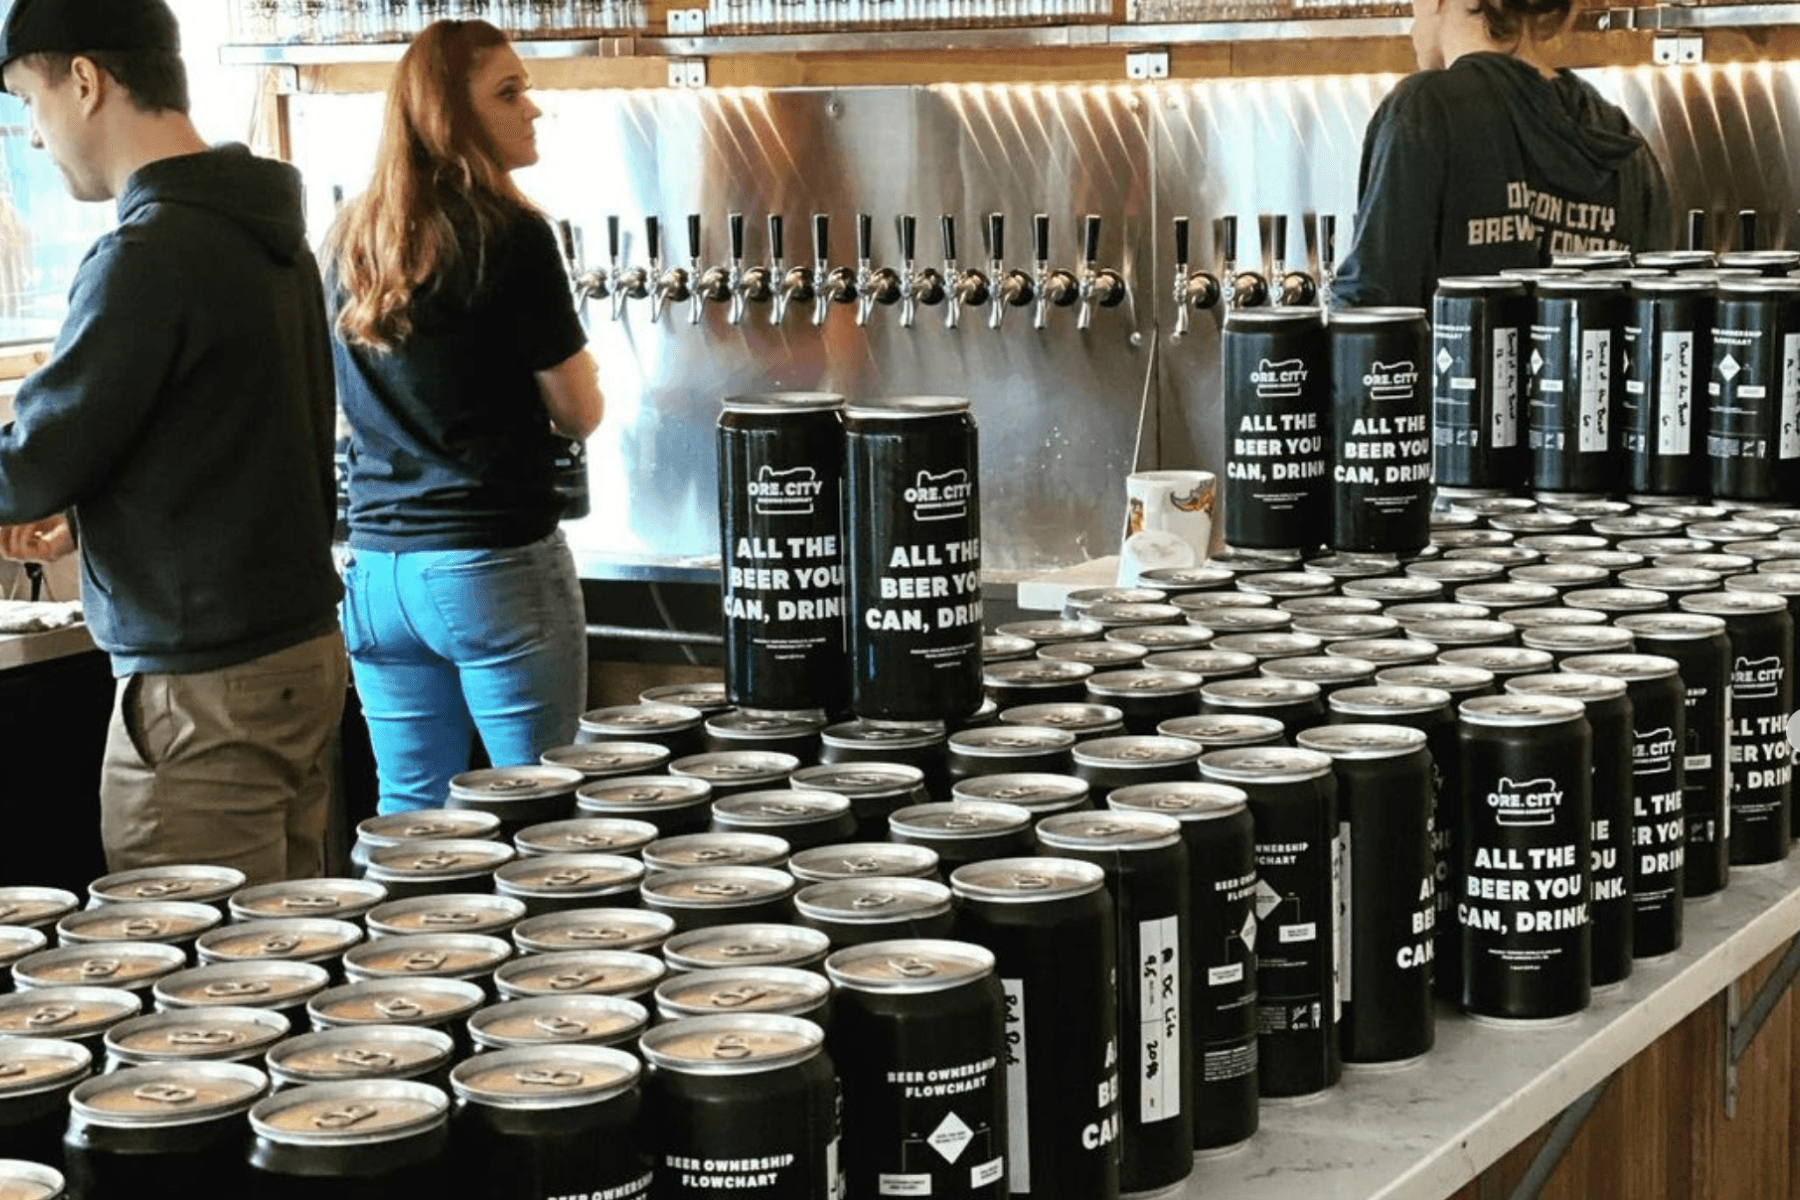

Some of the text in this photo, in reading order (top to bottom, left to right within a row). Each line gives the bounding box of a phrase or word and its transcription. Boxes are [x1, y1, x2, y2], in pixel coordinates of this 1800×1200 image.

[1566, 201, 1615, 232] CITY
[1240, 413, 1316, 432] ALL THE
[1352, 415, 1426, 435] ALL THE
[1234, 436, 1321, 456] BEER YOU
[1344, 438, 1429, 459] BEER YOU
[1227, 461, 1266, 482] CAN,
[1334, 465, 1379, 486] CAN,
[748, 481, 822, 496] ORE.CITY
[904, 483, 972, 502] ORE.CITY
[737, 535, 836, 559] ALL THE
[889, 538, 979, 568] ALL THE
[731, 565, 844, 590] BEER YOU
[881, 576, 949, 599] BEER
[724, 595, 770, 623] CAN,
[866, 600, 983, 633] CAN, DRIN
[1748, 764, 1792, 789] DRIN
[1487, 791, 1563, 807] ORE.CITY
[1651, 789, 1682, 815] THE
[1475, 845, 1576, 870] ALL THE
[1590, 847, 1617, 871] OU
[1641, 846, 1684, 875] DRIN
[1467, 873, 1582, 901] BEER YOU
[1458, 903, 1508, 935] CAN,
[887, 1057, 997, 1083] BEER OWNERSHIP
[905, 1075, 987, 1098] FLOWCHART
[666, 1153, 794, 1172] BEER OWNERSHIP
[682, 1172, 777, 1188] FLOWCHART
